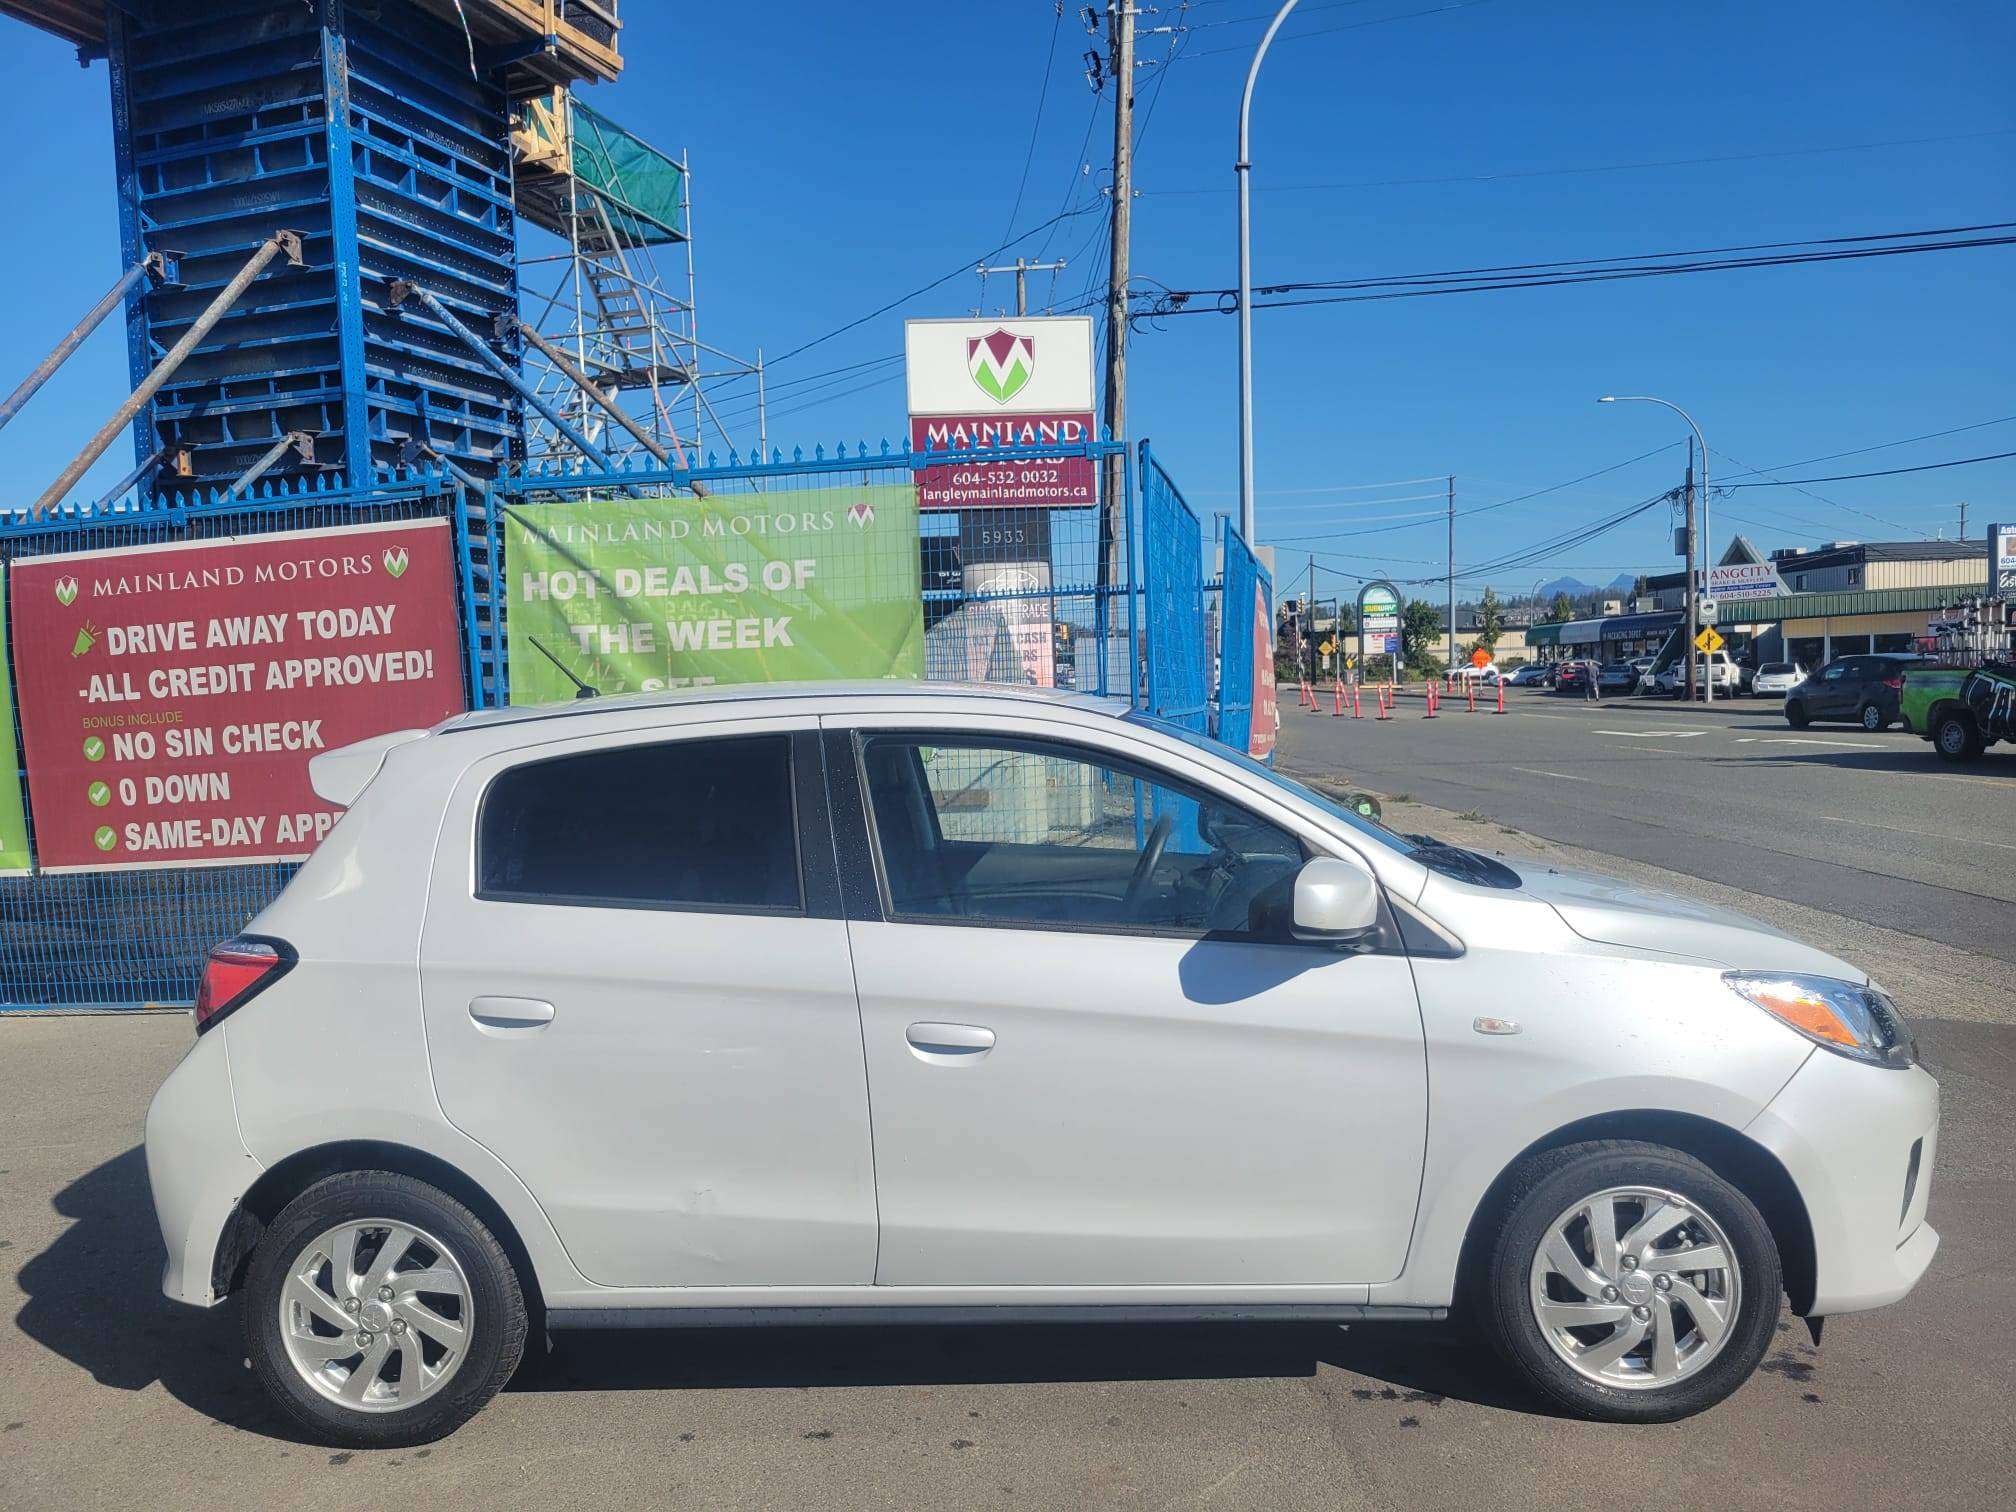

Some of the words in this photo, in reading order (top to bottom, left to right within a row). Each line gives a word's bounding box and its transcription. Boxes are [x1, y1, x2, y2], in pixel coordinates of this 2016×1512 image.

[928, 420, 1082, 444] MAINLAND
[924, 486, 1087, 502] langleymainlandmotors.ca
[1021, 470, 1058, 483] 0032
[522, 519, 690, 545] MAINLAND
[702, 511, 834, 538] MOTORS
[92, 566, 245, 598] MAINLAND
[254, 554, 373, 583] MOTORS
[522, 569, 600, 601] HOT
[616, 561, 749, 598] DEALS
[762, 559, 816, 590] OF
[1720, 590, 1771, 599] 604-510-5225
[107, 621, 197, 655] DRIVE
[206, 613, 288, 648] AWAY
[297, 604, 396, 640] TODAY
[570, 622, 656, 655] THE
[666, 616, 795, 652] WEEK
[79, 674, 140, 703] -ALL
[148, 662, 255, 697] CREDIT
[265, 649, 434, 690] APPROVED!
[82, 713, 125, 729] BONUS
[128, 710, 183, 725] INCLUDE
[113, 731, 156, 761] NO
[165, 727, 214, 758] SIN
[222, 719, 325, 754] CHECK
[119, 780, 136, 806] 0
[145, 772, 230, 805] DOWN
[124, 815, 266, 851] SAME-DAY
